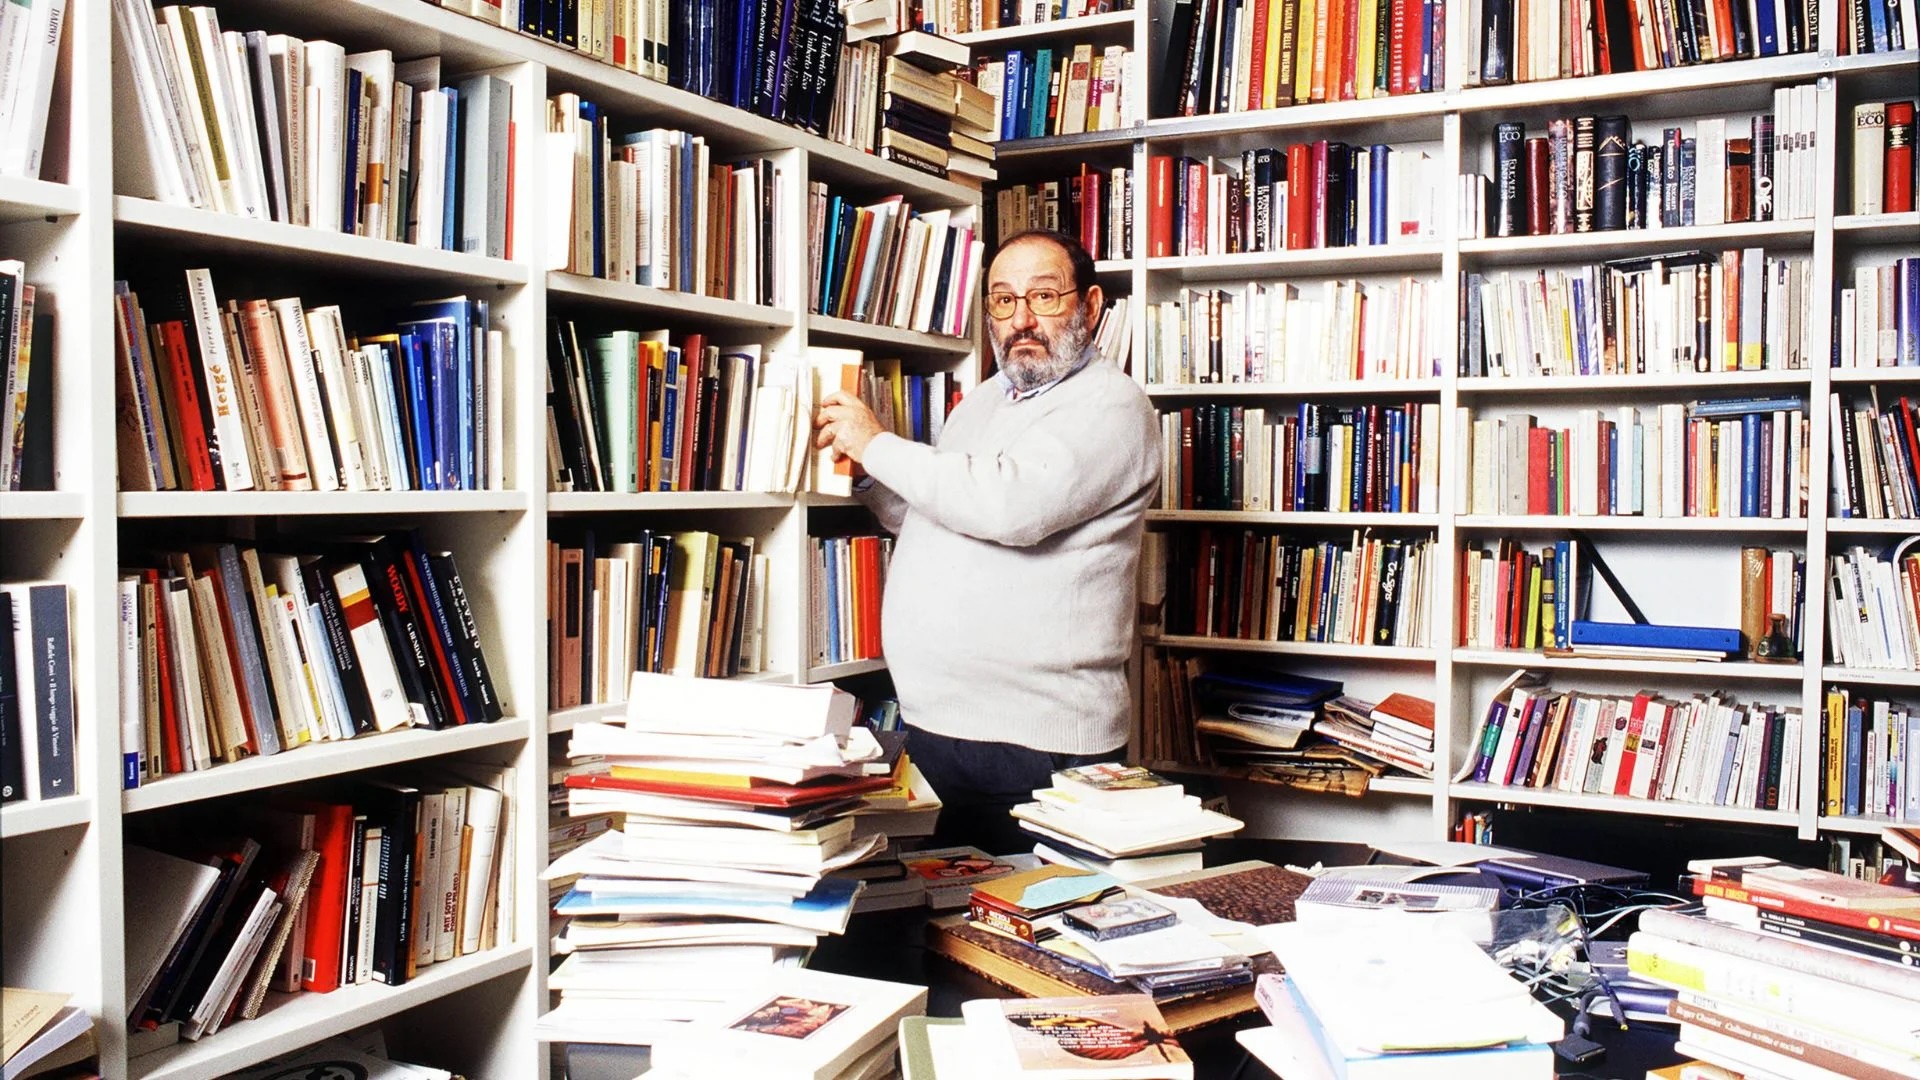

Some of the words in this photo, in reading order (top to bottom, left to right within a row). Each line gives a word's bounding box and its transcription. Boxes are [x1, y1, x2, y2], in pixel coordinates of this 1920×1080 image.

[47, 8, 60, 47] DARWIN
[1284, 4, 1294, 30] FIGURATA
[1855, 6, 1865, 47] EUGENIO
[805, 31, 818, 69] Umberto
[1283, 33, 1292, 49] DELLE
[766, 50, 777, 65] Eco
[783, 56, 793, 69] Eco
[819, 35, 832, 74] Umberto
[1007, 54, 1019, 74] ECO
[1281, 51, 1291, 84] INVENZIONI
[763, 65, 775, 97] Umberto
[802, 71, 812, 90] Eco
[816, 76, 826, 94] Eco
[290, 122, 298, 139] DEUX
[1857, 115, 1884, 127] ECO
[1499, 131, 1520, 143] ECO
[1258, 155, 1270, 163] ECO
[1257, 186, 1263, 196] DI
[195, 276, 209, 321] Assouline
[292, 305, 304, 337] ERMANNO
[205, 325, 217, 355] Pierre
[208, 364, 231, 417] Hergé
[1366, 422, 1374, 458] APOCALYPSE
[387, 564, 407, 613] WOODY
[1381, 575, 1396, 603] Signs
[1470, 583, 1478, 599] Films
[327, 598, 337, 618] DUCA
[333, 618, 340, 627] DI
[405, 622, 413, 631] G.
[408, 630, 426, 667] BENDAZZI
[48, 688, 57, 704] lungo
[48, 705, 59, 725] viaggio
[1767, 786, 1776, 806] ECO
[444, 891, 453, 915] SOTTO
[1674, 1005, 1695, 1020] Roger
[1694, 1012, 1722, 1027] Chartier
